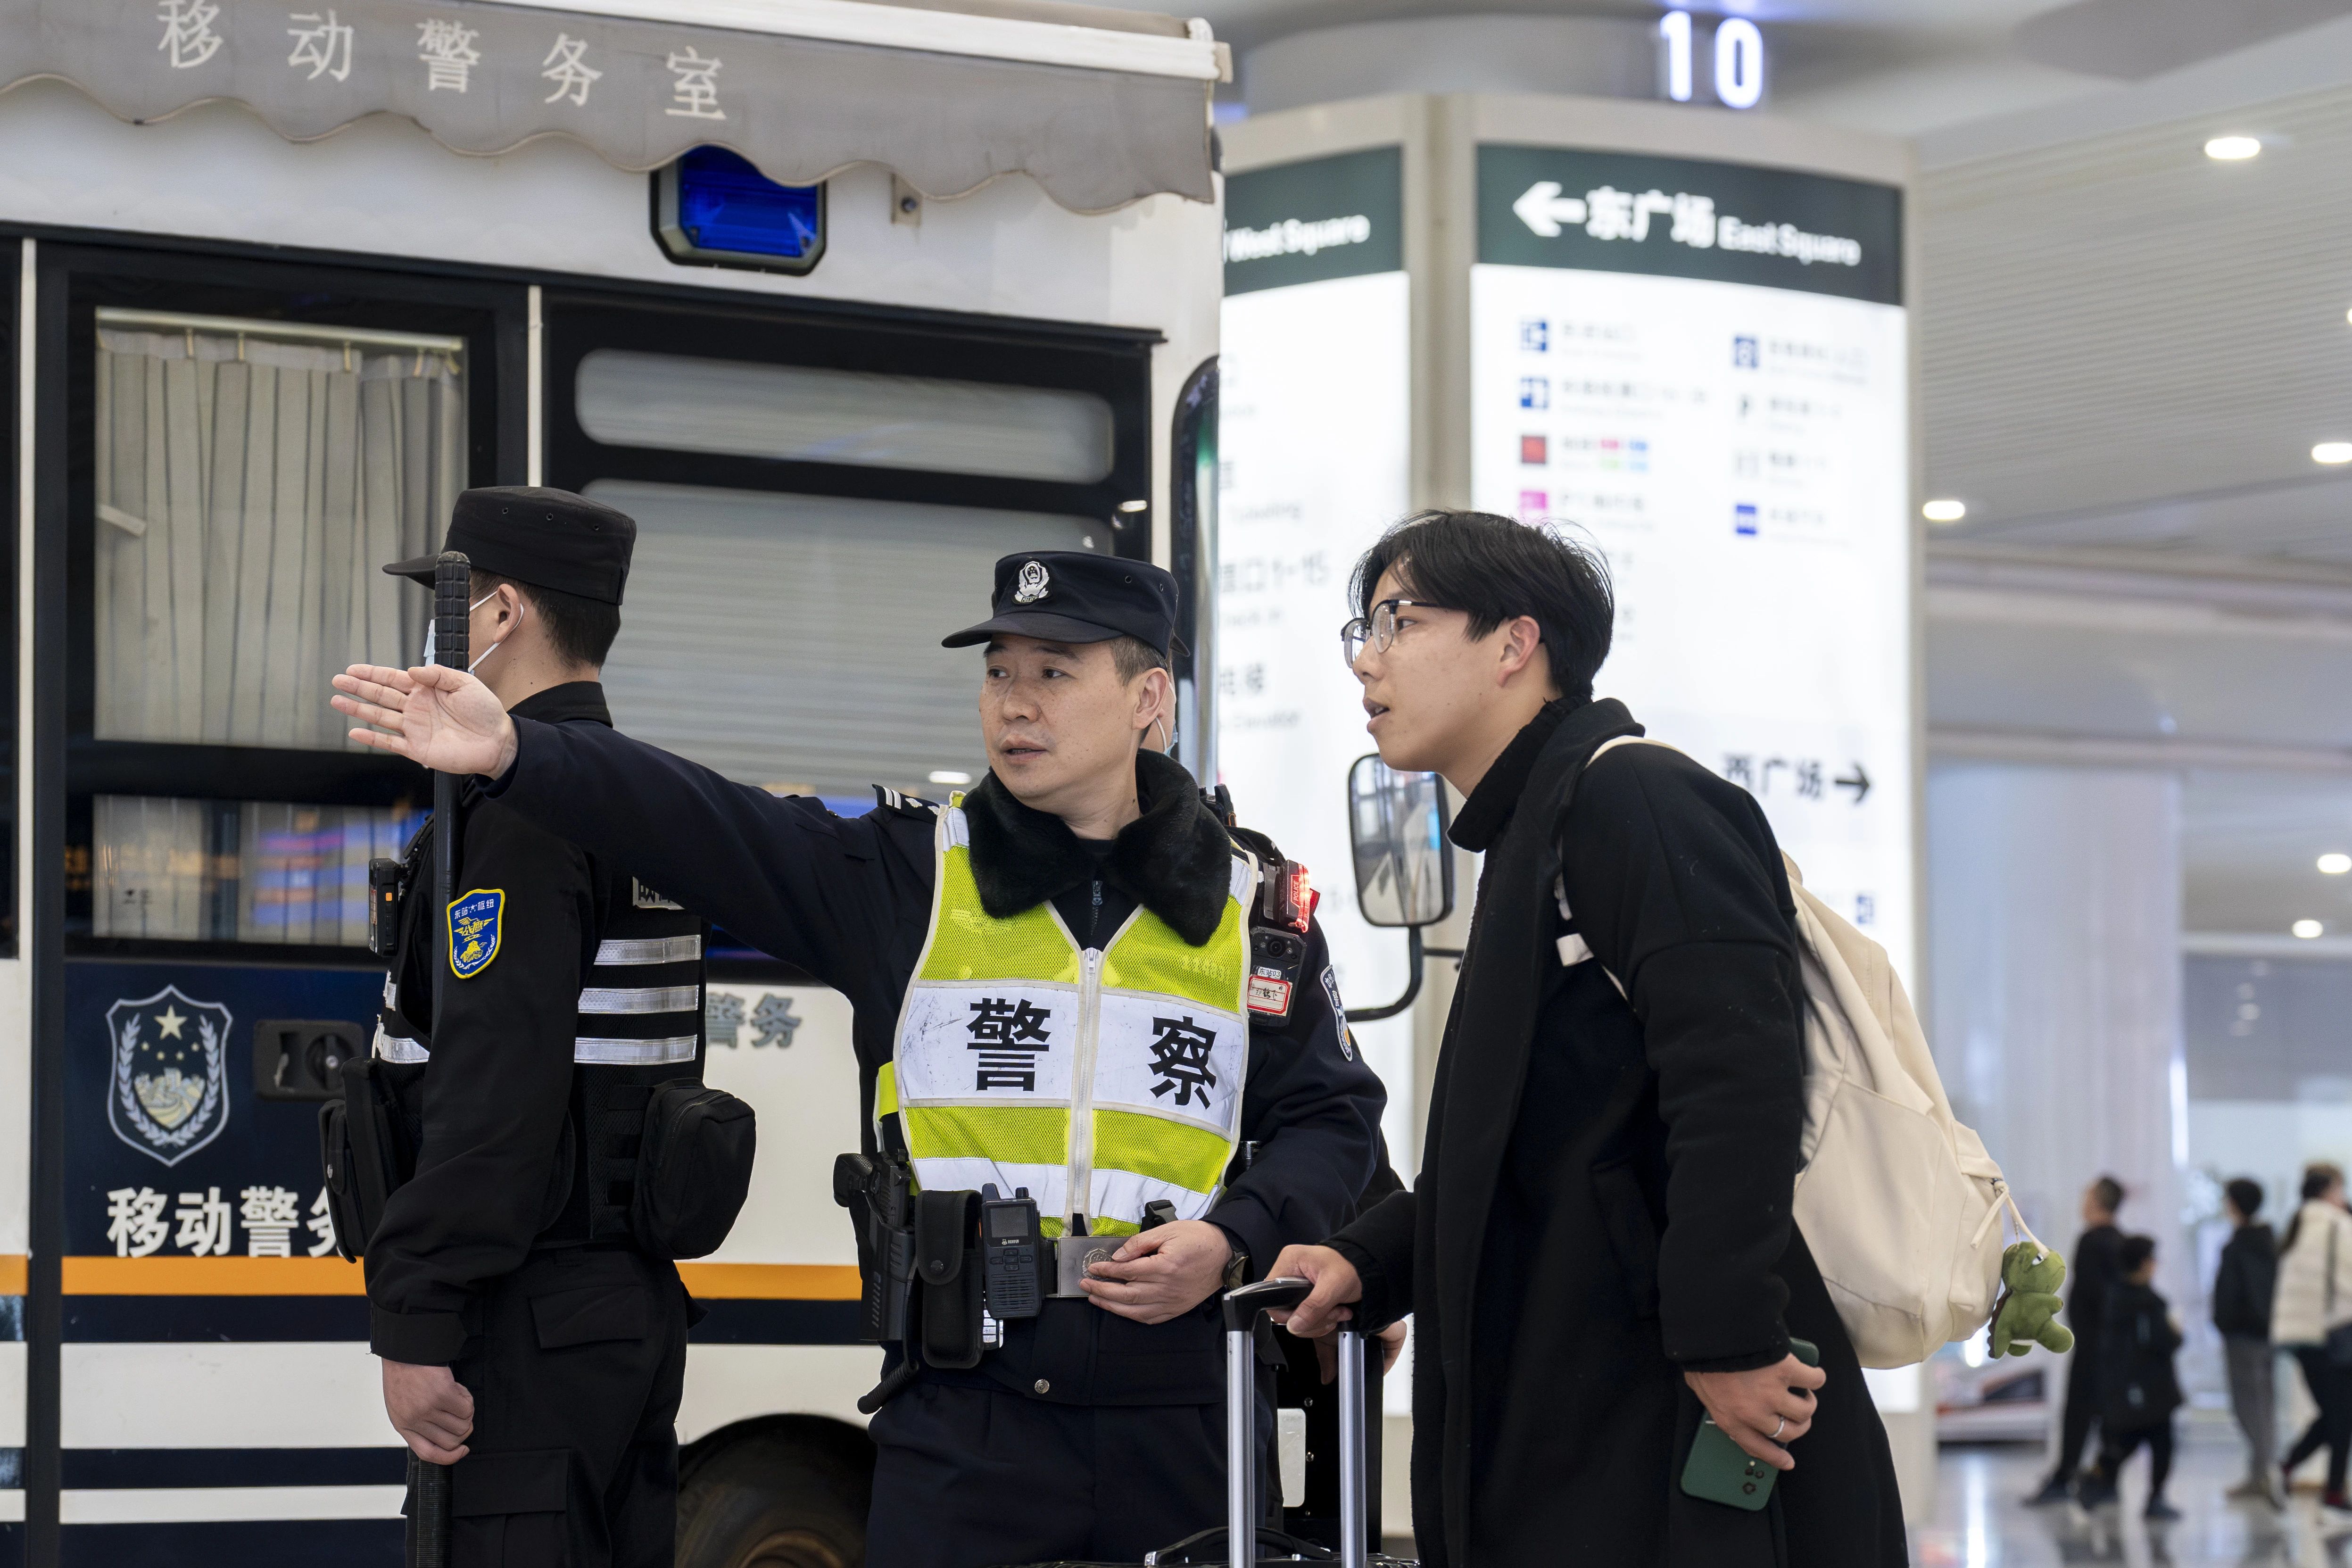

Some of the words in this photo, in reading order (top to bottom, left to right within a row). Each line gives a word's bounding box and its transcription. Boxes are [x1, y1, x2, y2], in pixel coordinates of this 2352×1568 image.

[157, 0, 727, 121] 移动警务室
[1661, 9, 1765, 109] 10
